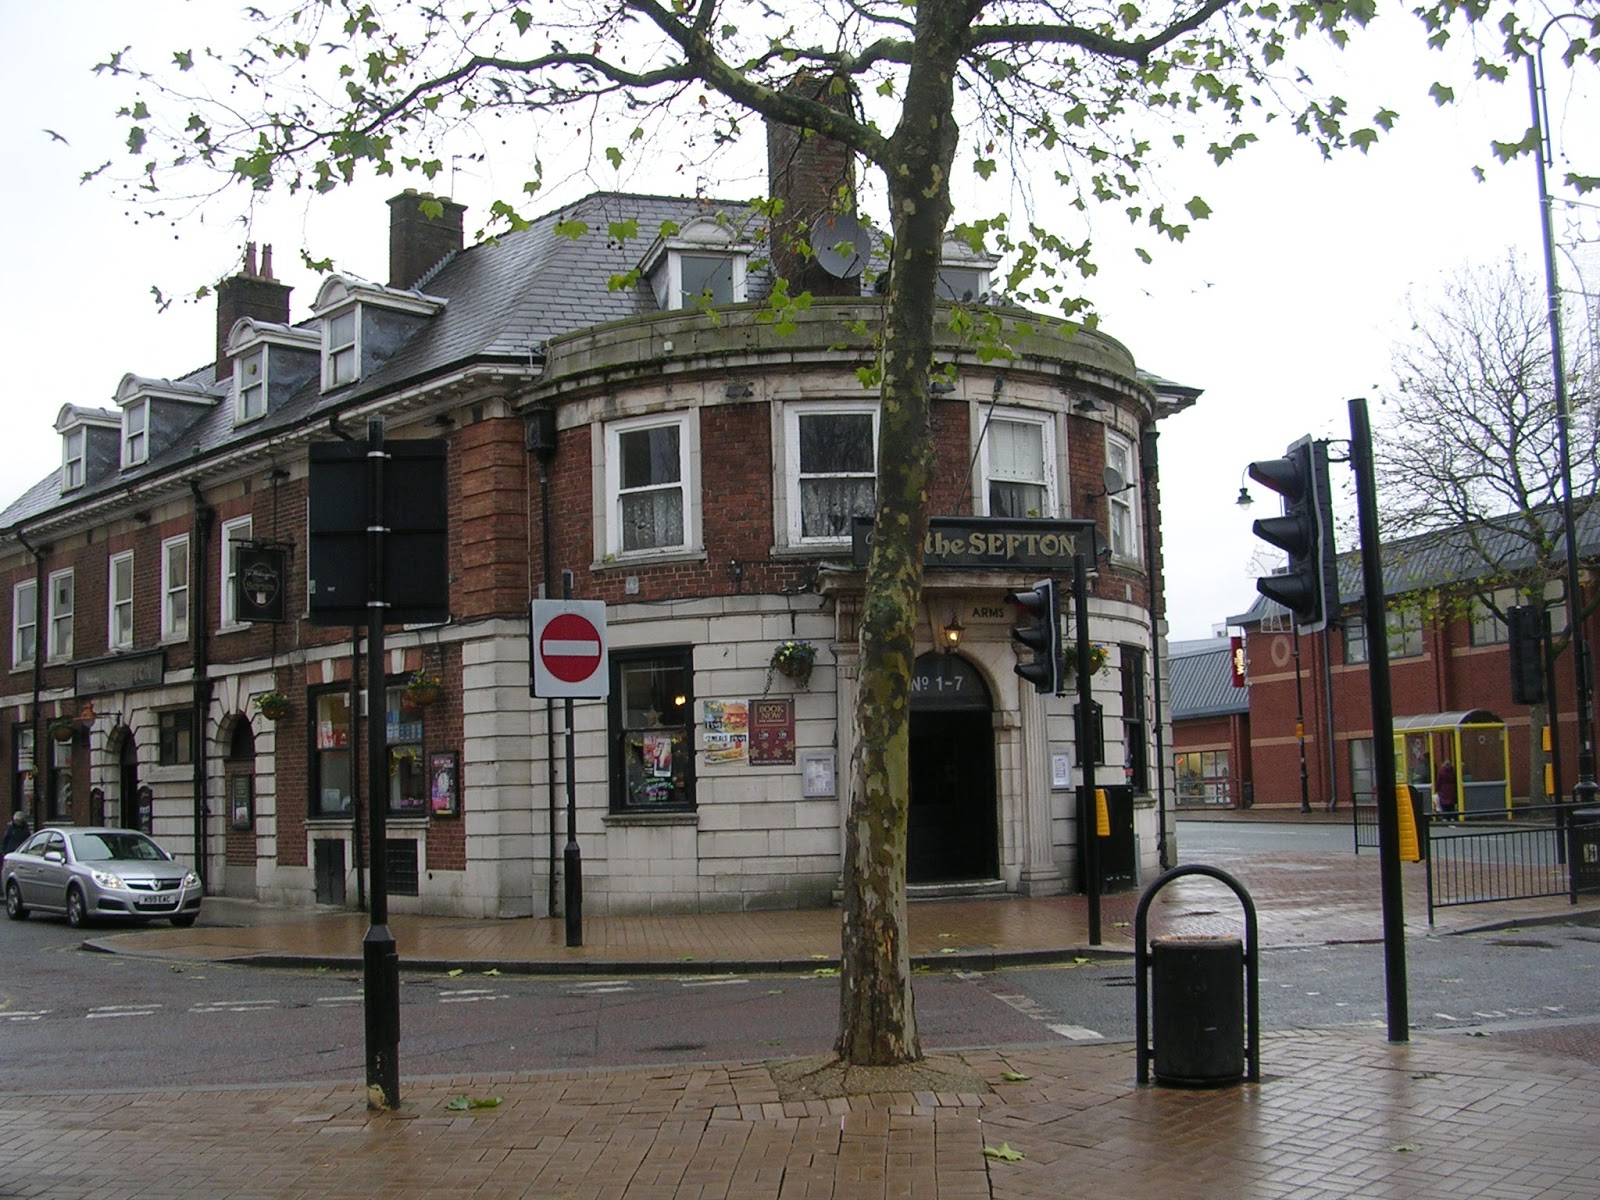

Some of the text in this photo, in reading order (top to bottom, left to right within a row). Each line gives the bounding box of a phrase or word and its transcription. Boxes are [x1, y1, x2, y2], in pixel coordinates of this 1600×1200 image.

[924, 532, 1078, 560] the SEFTON
[972, 607, 1005, 618] ARMS
[1234, 648, 1244, 675] wilko
[936, 676, 964, 691] 1-7
[759, 705, 784, 713] BOOK
